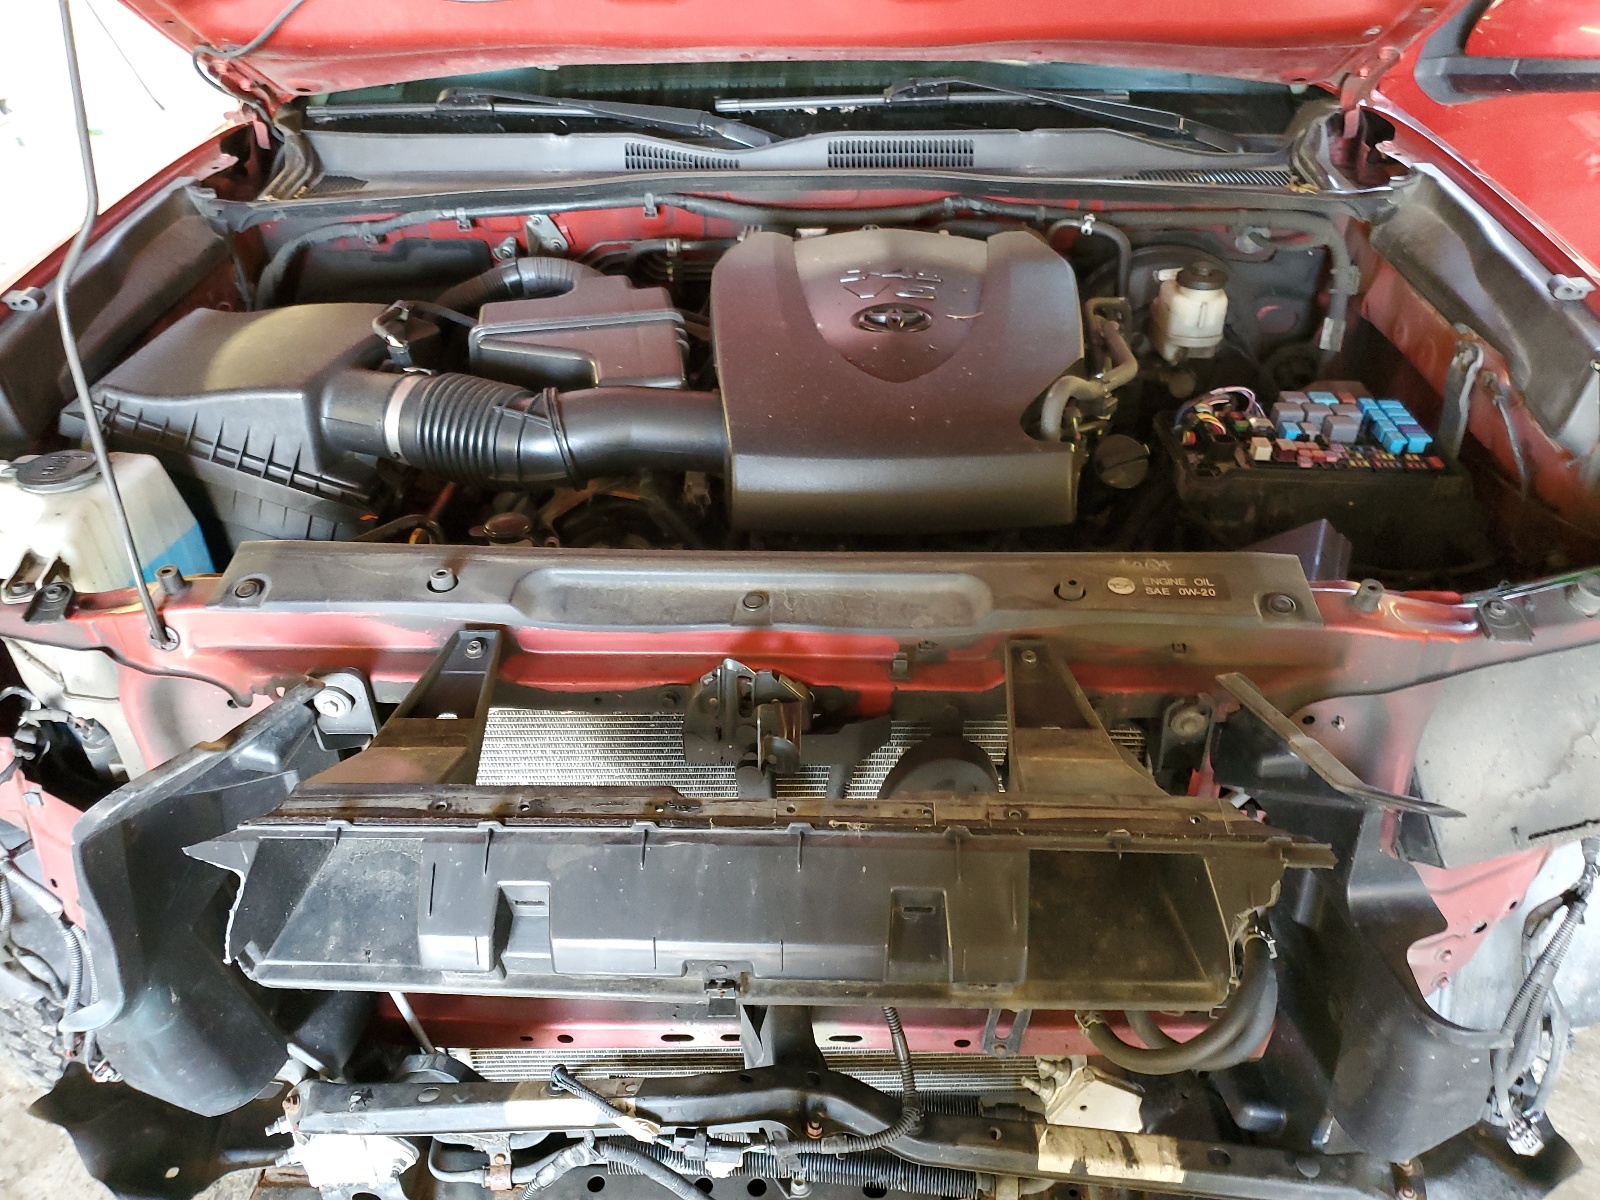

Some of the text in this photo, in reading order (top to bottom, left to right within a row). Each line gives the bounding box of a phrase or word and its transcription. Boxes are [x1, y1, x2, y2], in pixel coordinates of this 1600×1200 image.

[1142, 577, 1215, 587] ENGINE OIL
[1145, 587, 1216, 597] SAE 0W-20
